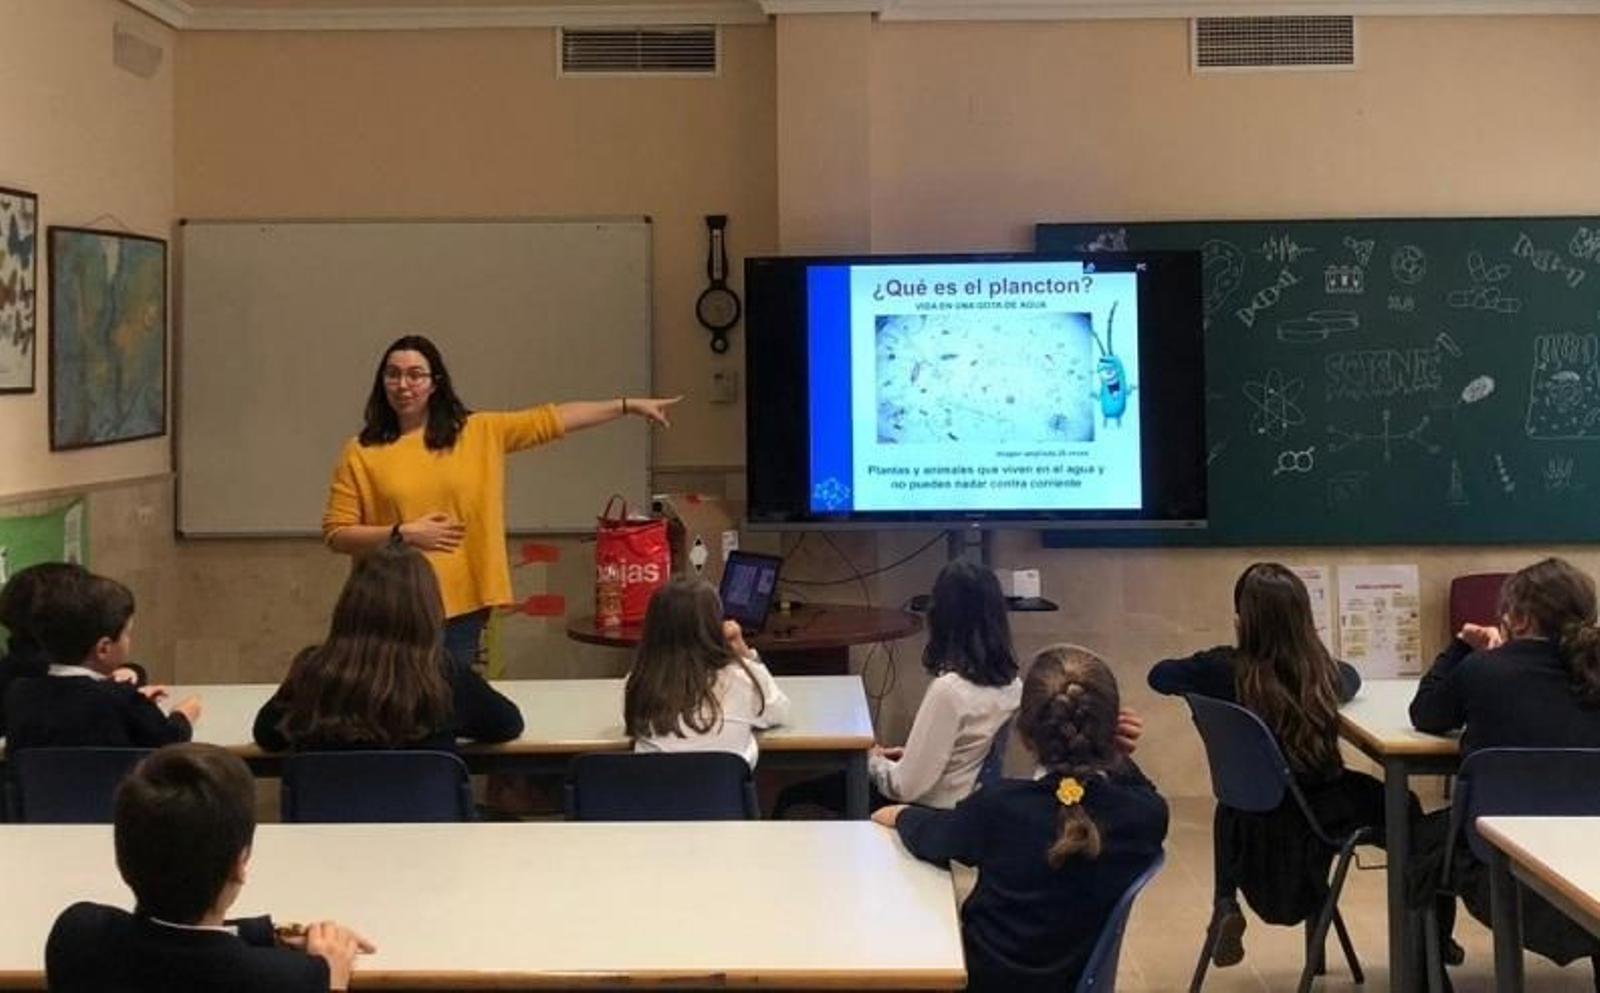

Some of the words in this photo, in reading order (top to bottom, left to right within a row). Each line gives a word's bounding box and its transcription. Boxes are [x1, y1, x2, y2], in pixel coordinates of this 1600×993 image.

[873, 278, 928, 301] ¿Qué
[934, 280, 958, 296] es
[964, 278, 982, 296] el
[989, 275, 1094, 299] plancton?
[1019, 301, 1047, 310] AGUA
[867, 464, 911, 476] Plantas
[912, 466, 921, 477] y
[923, 463, 975, 475] animales
[976, 465, 999, 477] que
[1001, 464, 1034, 475] viven
[1036, 465, 1050, 475] en
[1052, 462, 1064, 475] el
[1065, 463, 1095, 476] agua
[1097, 464, 1105, 476] y
[890, 480, 907, 489] no
[908, 479, 952, 491] pueden
[954, 479, 988, 489] nadar
[989, 479, 1028, 489] contra
[1029, 479, 1082, 489] corriente
